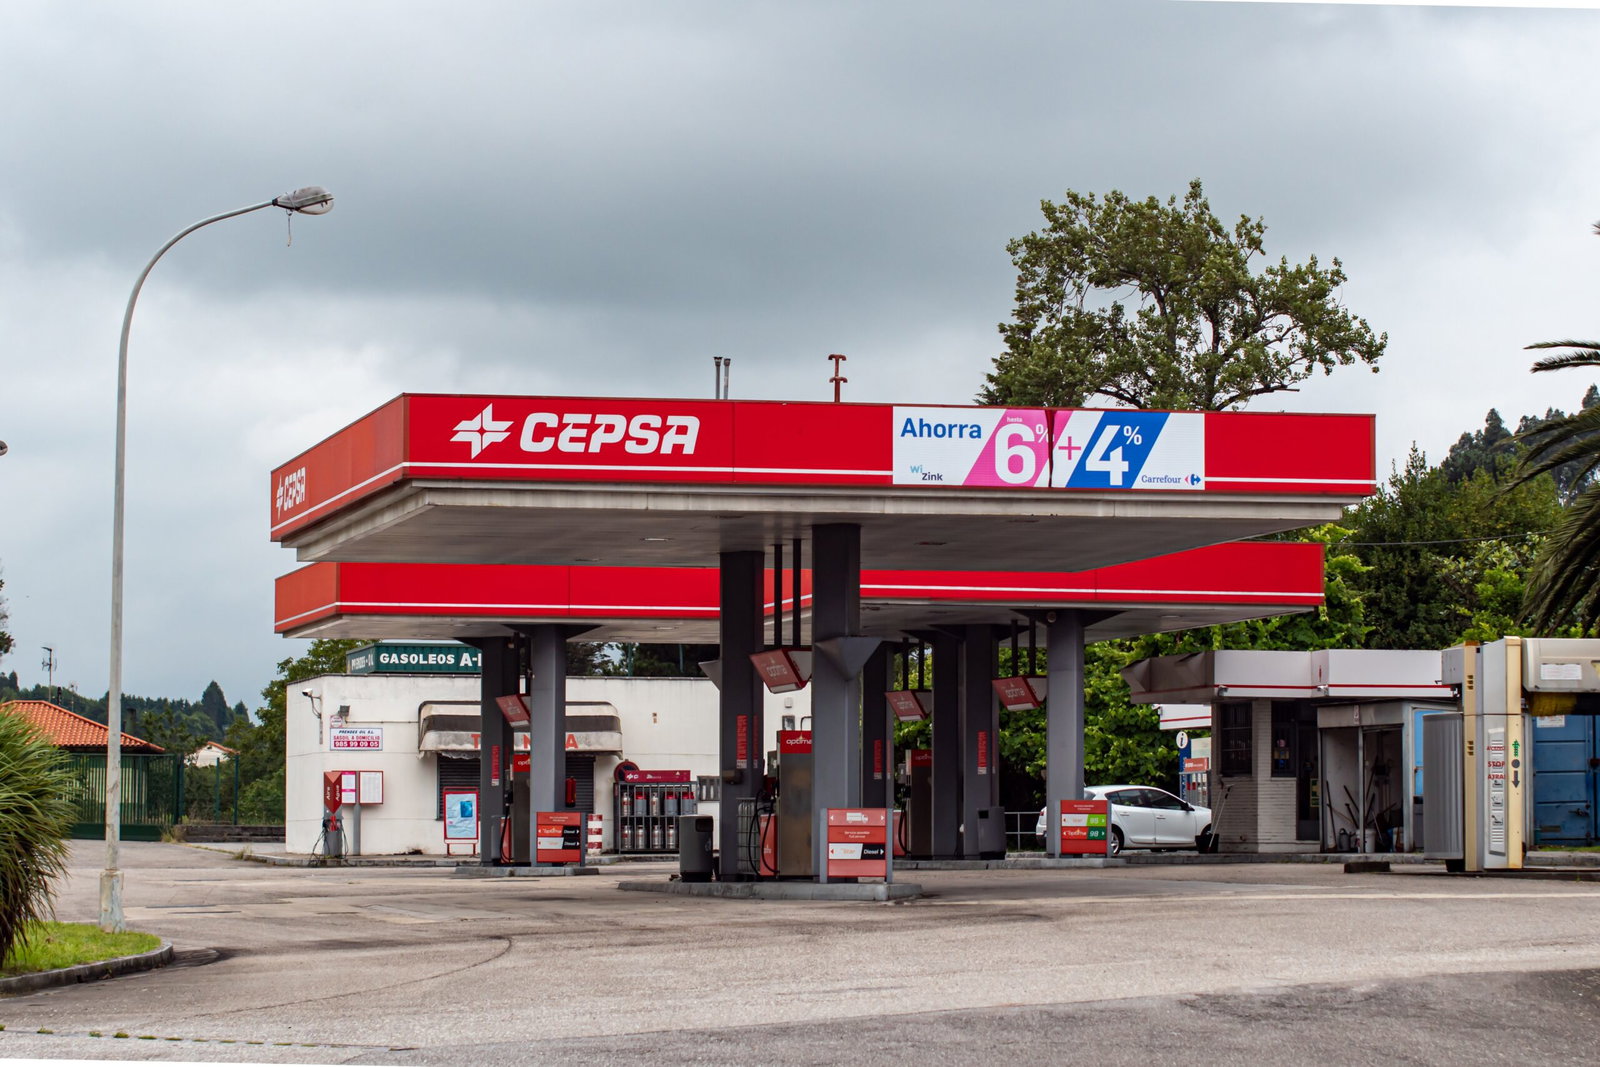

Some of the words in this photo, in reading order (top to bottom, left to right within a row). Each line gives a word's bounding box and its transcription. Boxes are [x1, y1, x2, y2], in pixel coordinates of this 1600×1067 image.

[519, 412, 700, 455] CEPSA
[900, 417, 982, 439] Ahorra
[921, 472, 943, 481] Zink
[1141, 474, 1182, 484] Carrefour
[283, 466, 306, 512] CEPSA
[379, 653, 455, 664] GASOLEOS
[1089, 830, 1099, 838] 98
